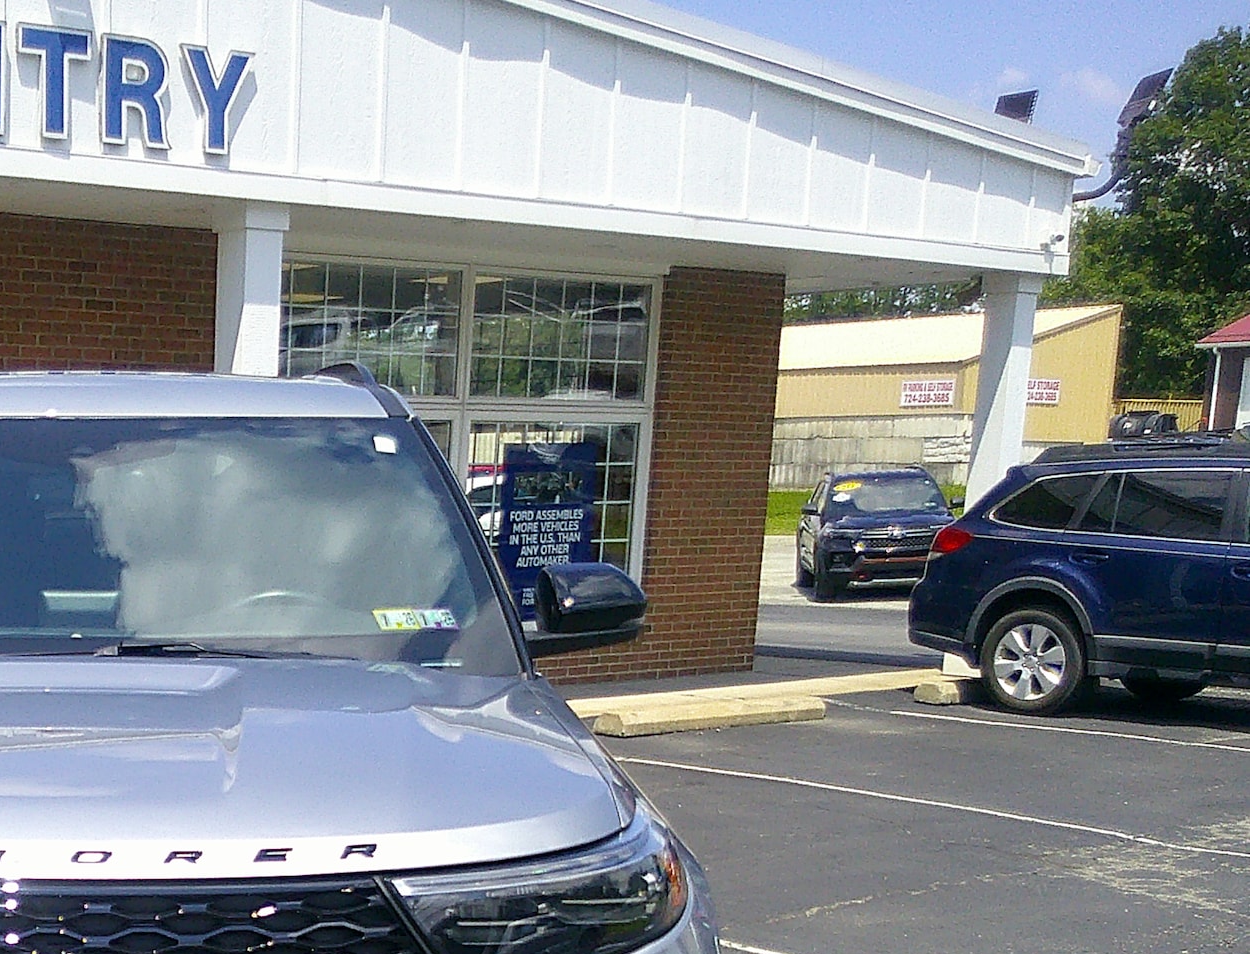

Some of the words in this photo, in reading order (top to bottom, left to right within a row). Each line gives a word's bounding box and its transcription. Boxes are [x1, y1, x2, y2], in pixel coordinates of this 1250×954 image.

[937, 382, 953, 391] STORAGE
[1027, 380, 1037, 390] ELF
[1037, 381, 1060, 391] STORAGE
[904, 393, 950, 403] 724-238-3685
[1027, 391, 1057, 401] 24-238-3685
[510, 510, 534, 522] FORD
[535, 509, 584, 520] ASSEMBLES
[512, 522, 539, 533] MORE
[540, 521, 579, 532] VEHICLES
[509, 534, 519, 545] IN
[520, 533, 539, 544] THE
[539, 533, 555, 543] U.S.
[557, 532, 581, 542] THAN
[520, 545, 539, 556] ANY
[540, 544, 570, 555] OTHER
